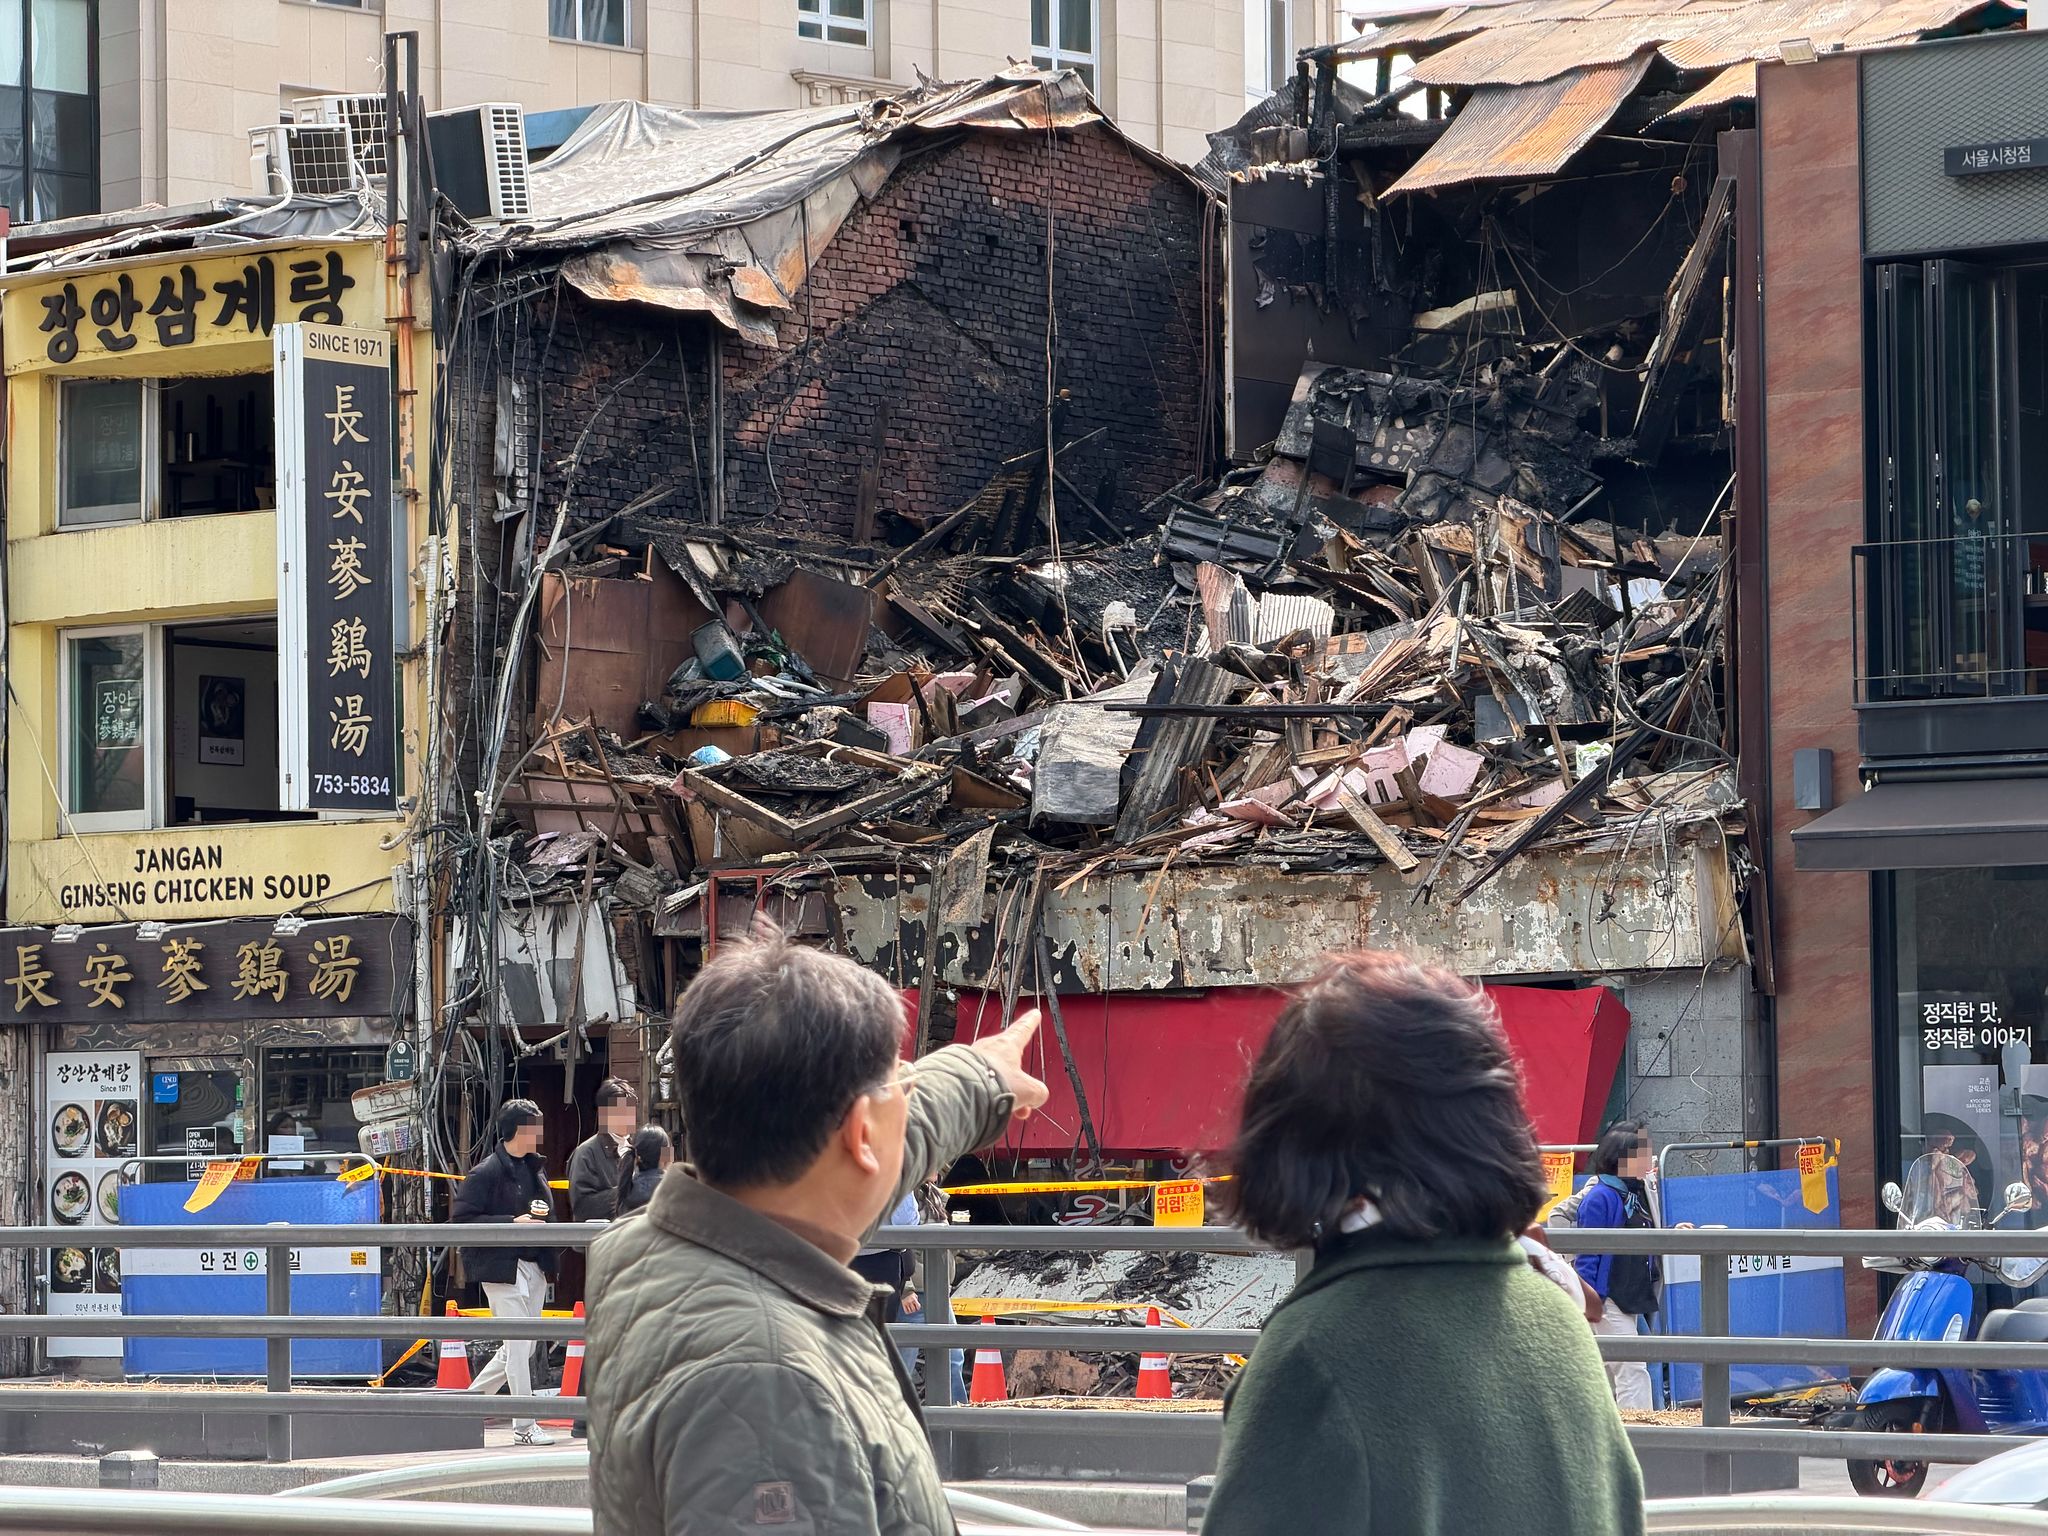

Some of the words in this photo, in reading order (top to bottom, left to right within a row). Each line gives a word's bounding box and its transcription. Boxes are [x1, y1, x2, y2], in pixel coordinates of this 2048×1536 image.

[1962, 146, 2031, 168] 서울시청점
[39, 251, 356, 364] 장안삼계탕
[308, 332, 351, 354] SINCE
[353, 336, 384, 358] 1971
[103, 690, 134, 714] 장안
[313, 774, 391, 796] 753-5834
[133, 845, 223, 875] JANGAN
[60, 880, 147, 909] GINSENG
[154, 876, 255, 905] CHICKEN
[264, 873, 332, 900] SOUP
[1923, 1002, 1975, 1025] 정직한
[1980, 1001, 2002, 1025] 맛,
[1923, 1027, 1976, 1050] 정직한
[1981, 1026, 2033, 1049] 이야기
[57, 1063, 131, 1083] 장안삼계탕
[100, 1084, 117, 1093] Since
[118, 1084, 132, 1093] 1971
[1157, 1196, 1185, 1214] 위험!
